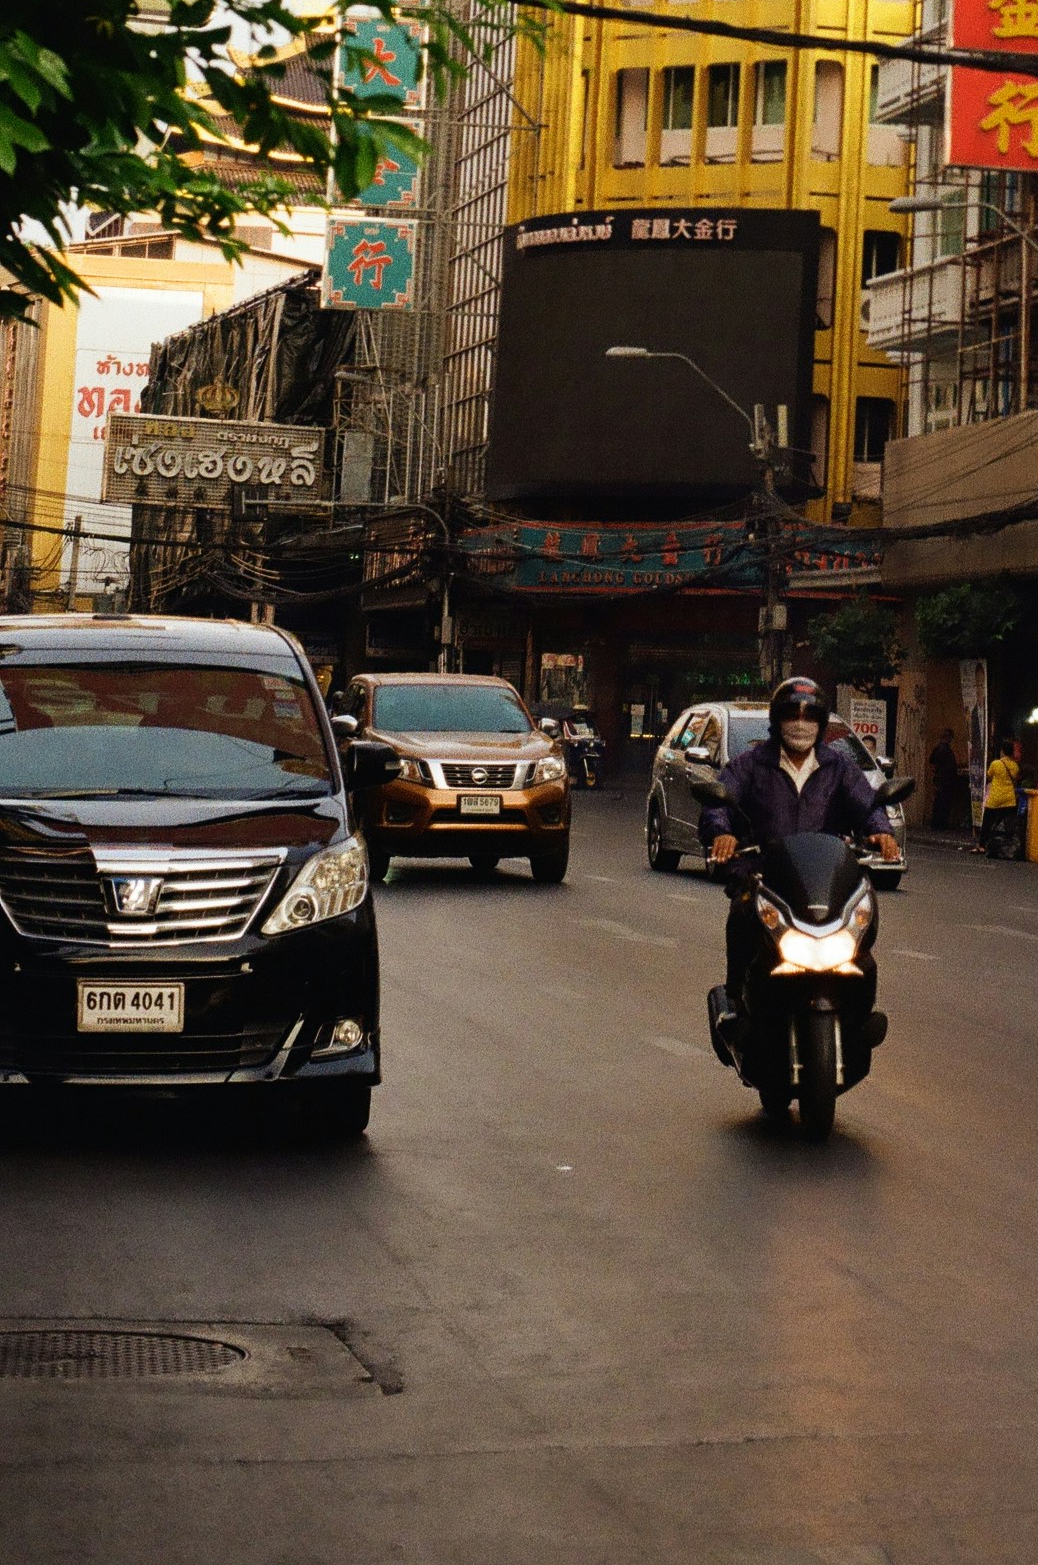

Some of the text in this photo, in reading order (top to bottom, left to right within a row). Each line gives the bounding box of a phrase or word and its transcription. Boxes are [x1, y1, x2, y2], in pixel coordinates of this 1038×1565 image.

[853, 722, 879, 734] 700
[86, 991, 175, 1011] 6กต 4041
